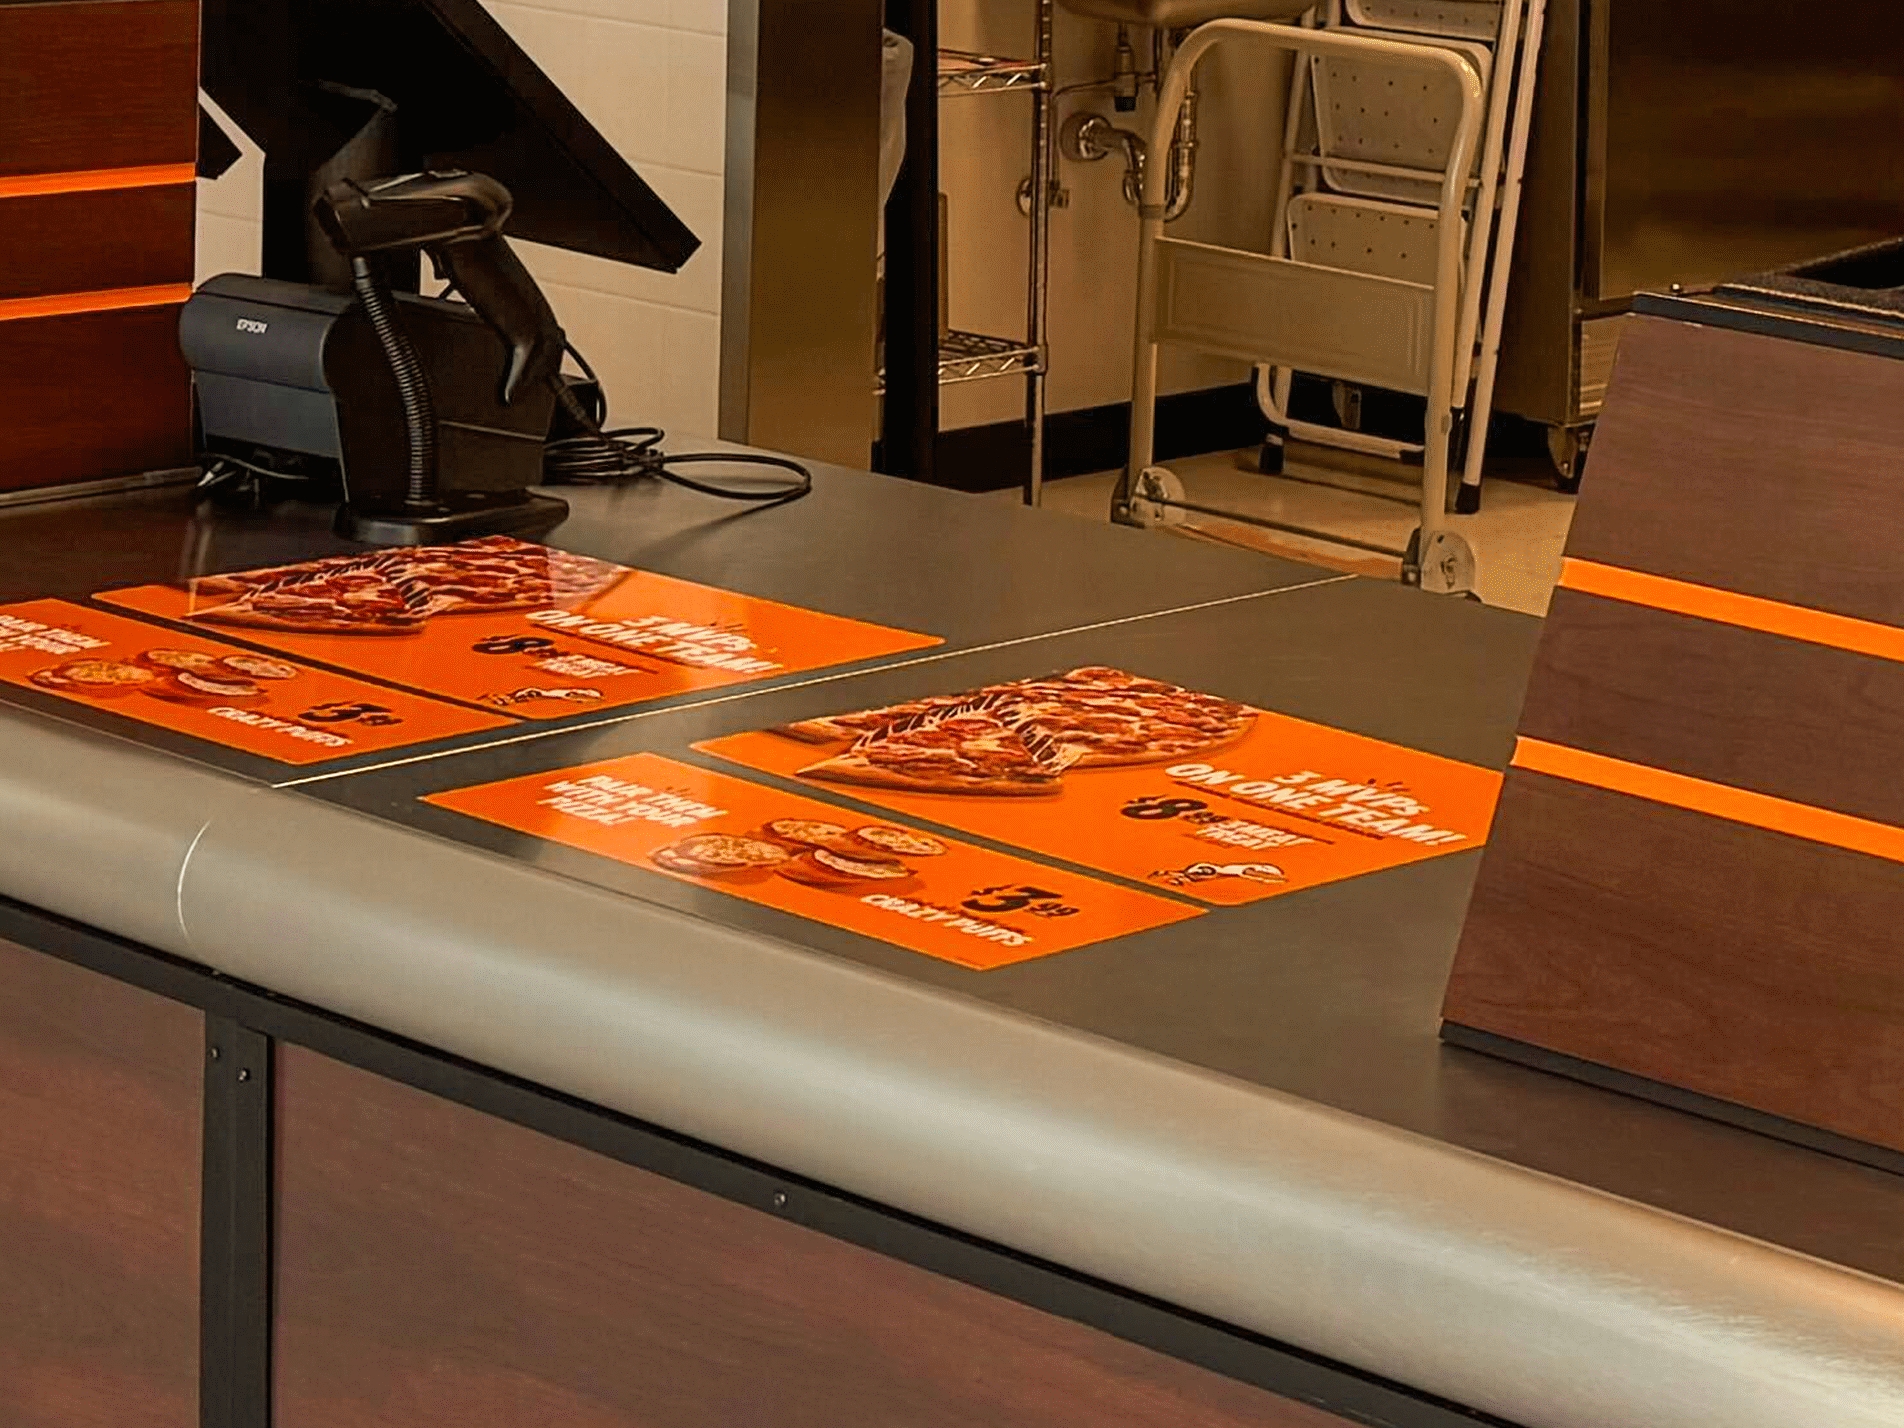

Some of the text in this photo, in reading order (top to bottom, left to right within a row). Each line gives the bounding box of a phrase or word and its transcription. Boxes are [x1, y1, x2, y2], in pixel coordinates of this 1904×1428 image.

[236, 318, 268, 334] EPSON
[1165, 763, 1468, 845] ON ONE TEAM!
